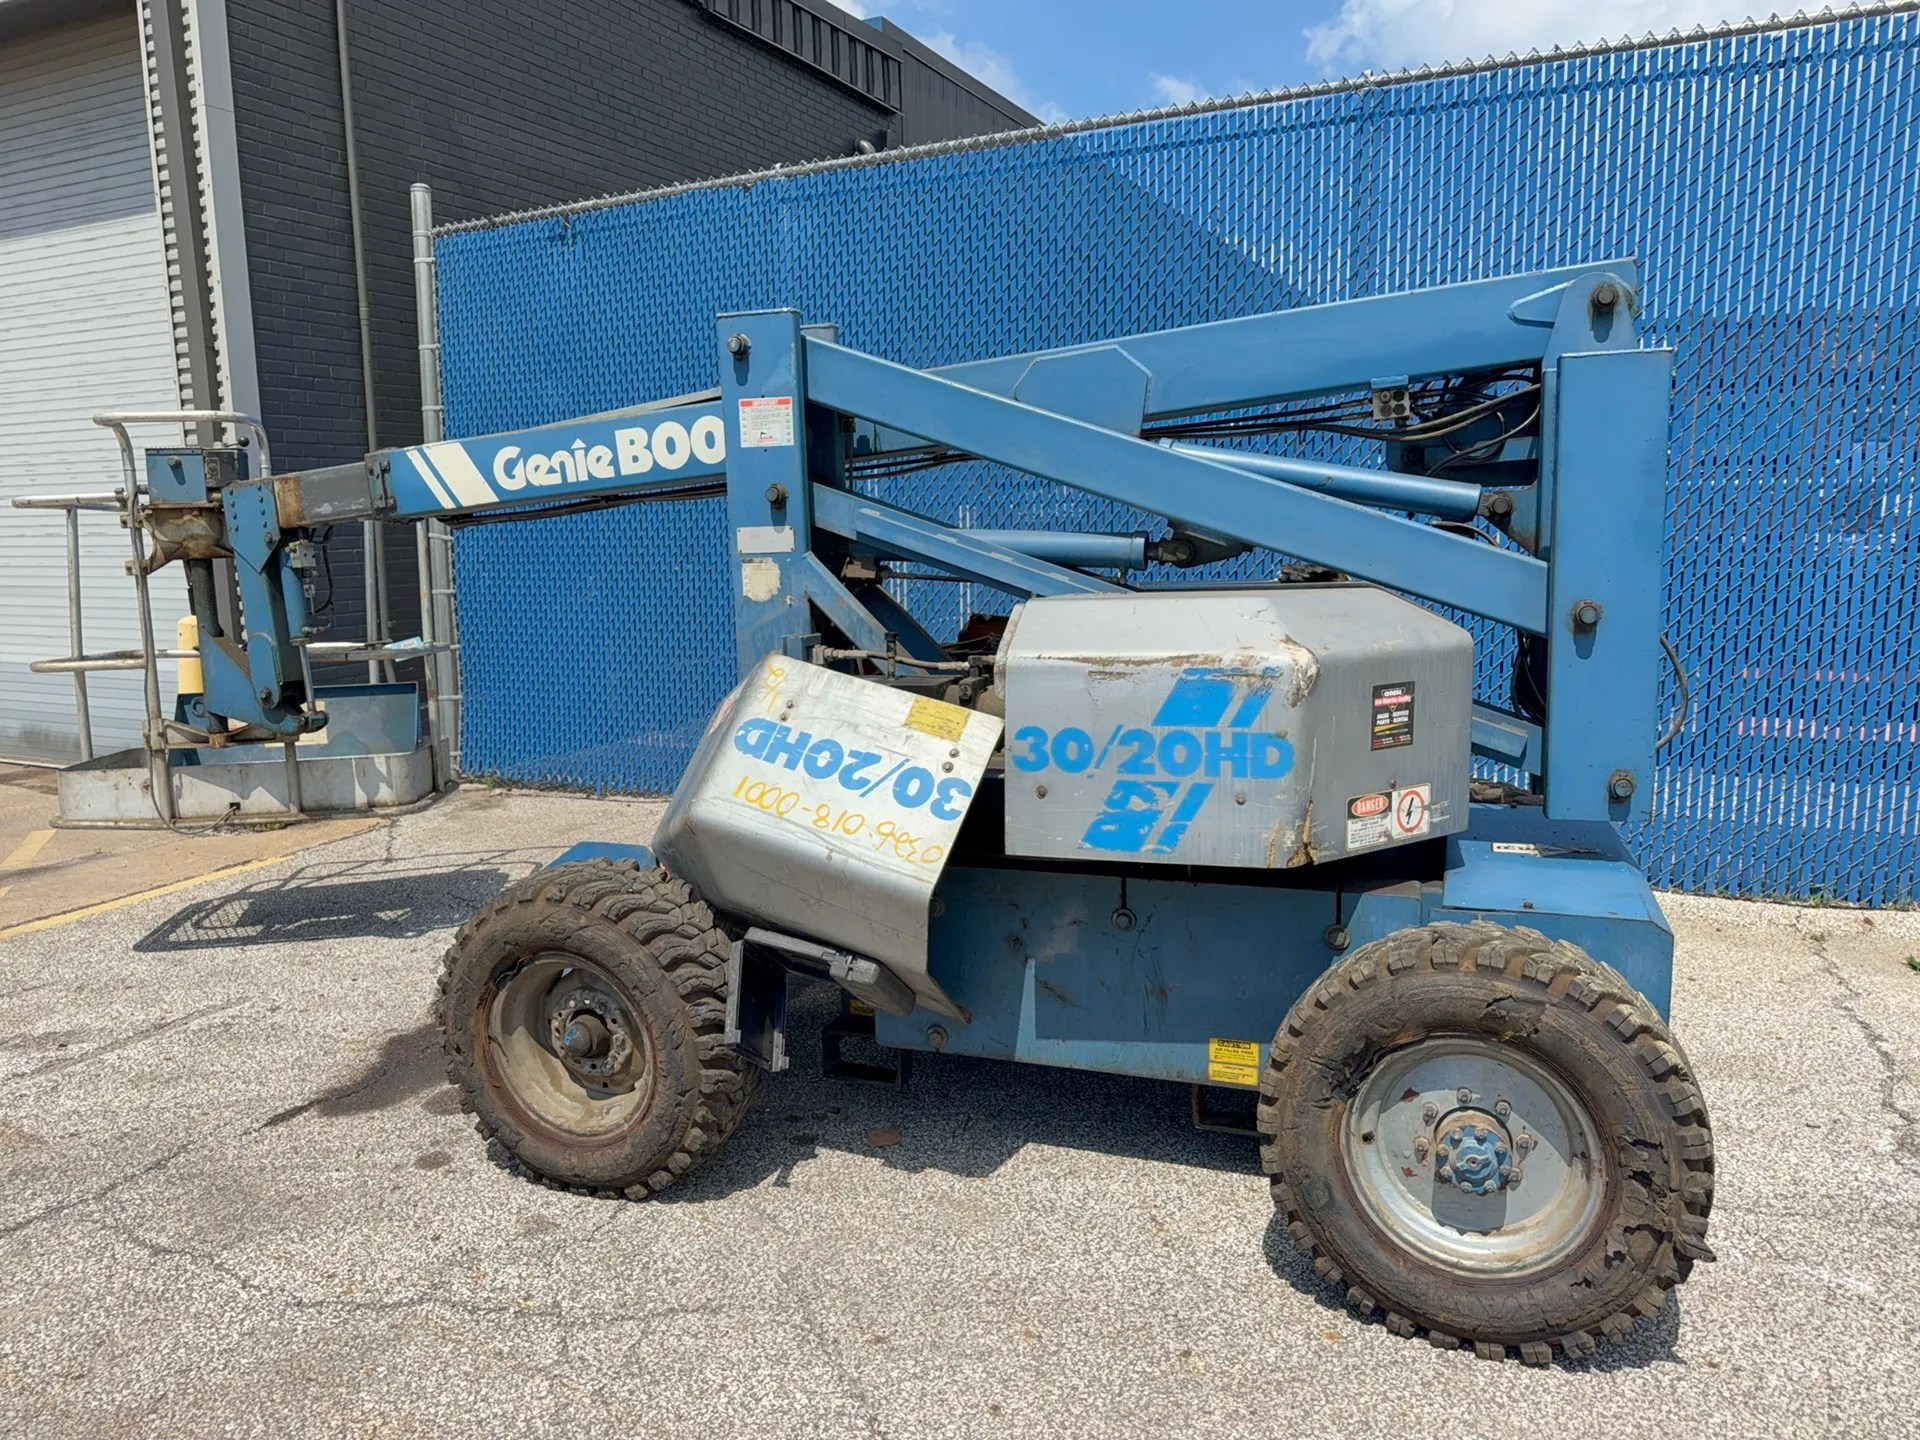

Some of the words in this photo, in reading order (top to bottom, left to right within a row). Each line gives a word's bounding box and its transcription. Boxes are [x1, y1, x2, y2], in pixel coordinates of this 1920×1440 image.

[734, 717, 973, 821] 30/20HD
[1011, 724, 1296, 780] 30/20HD
[1357, 798, 1385, 814] DANGER
[1218, 1040, 1250, 1049] CAUTION
